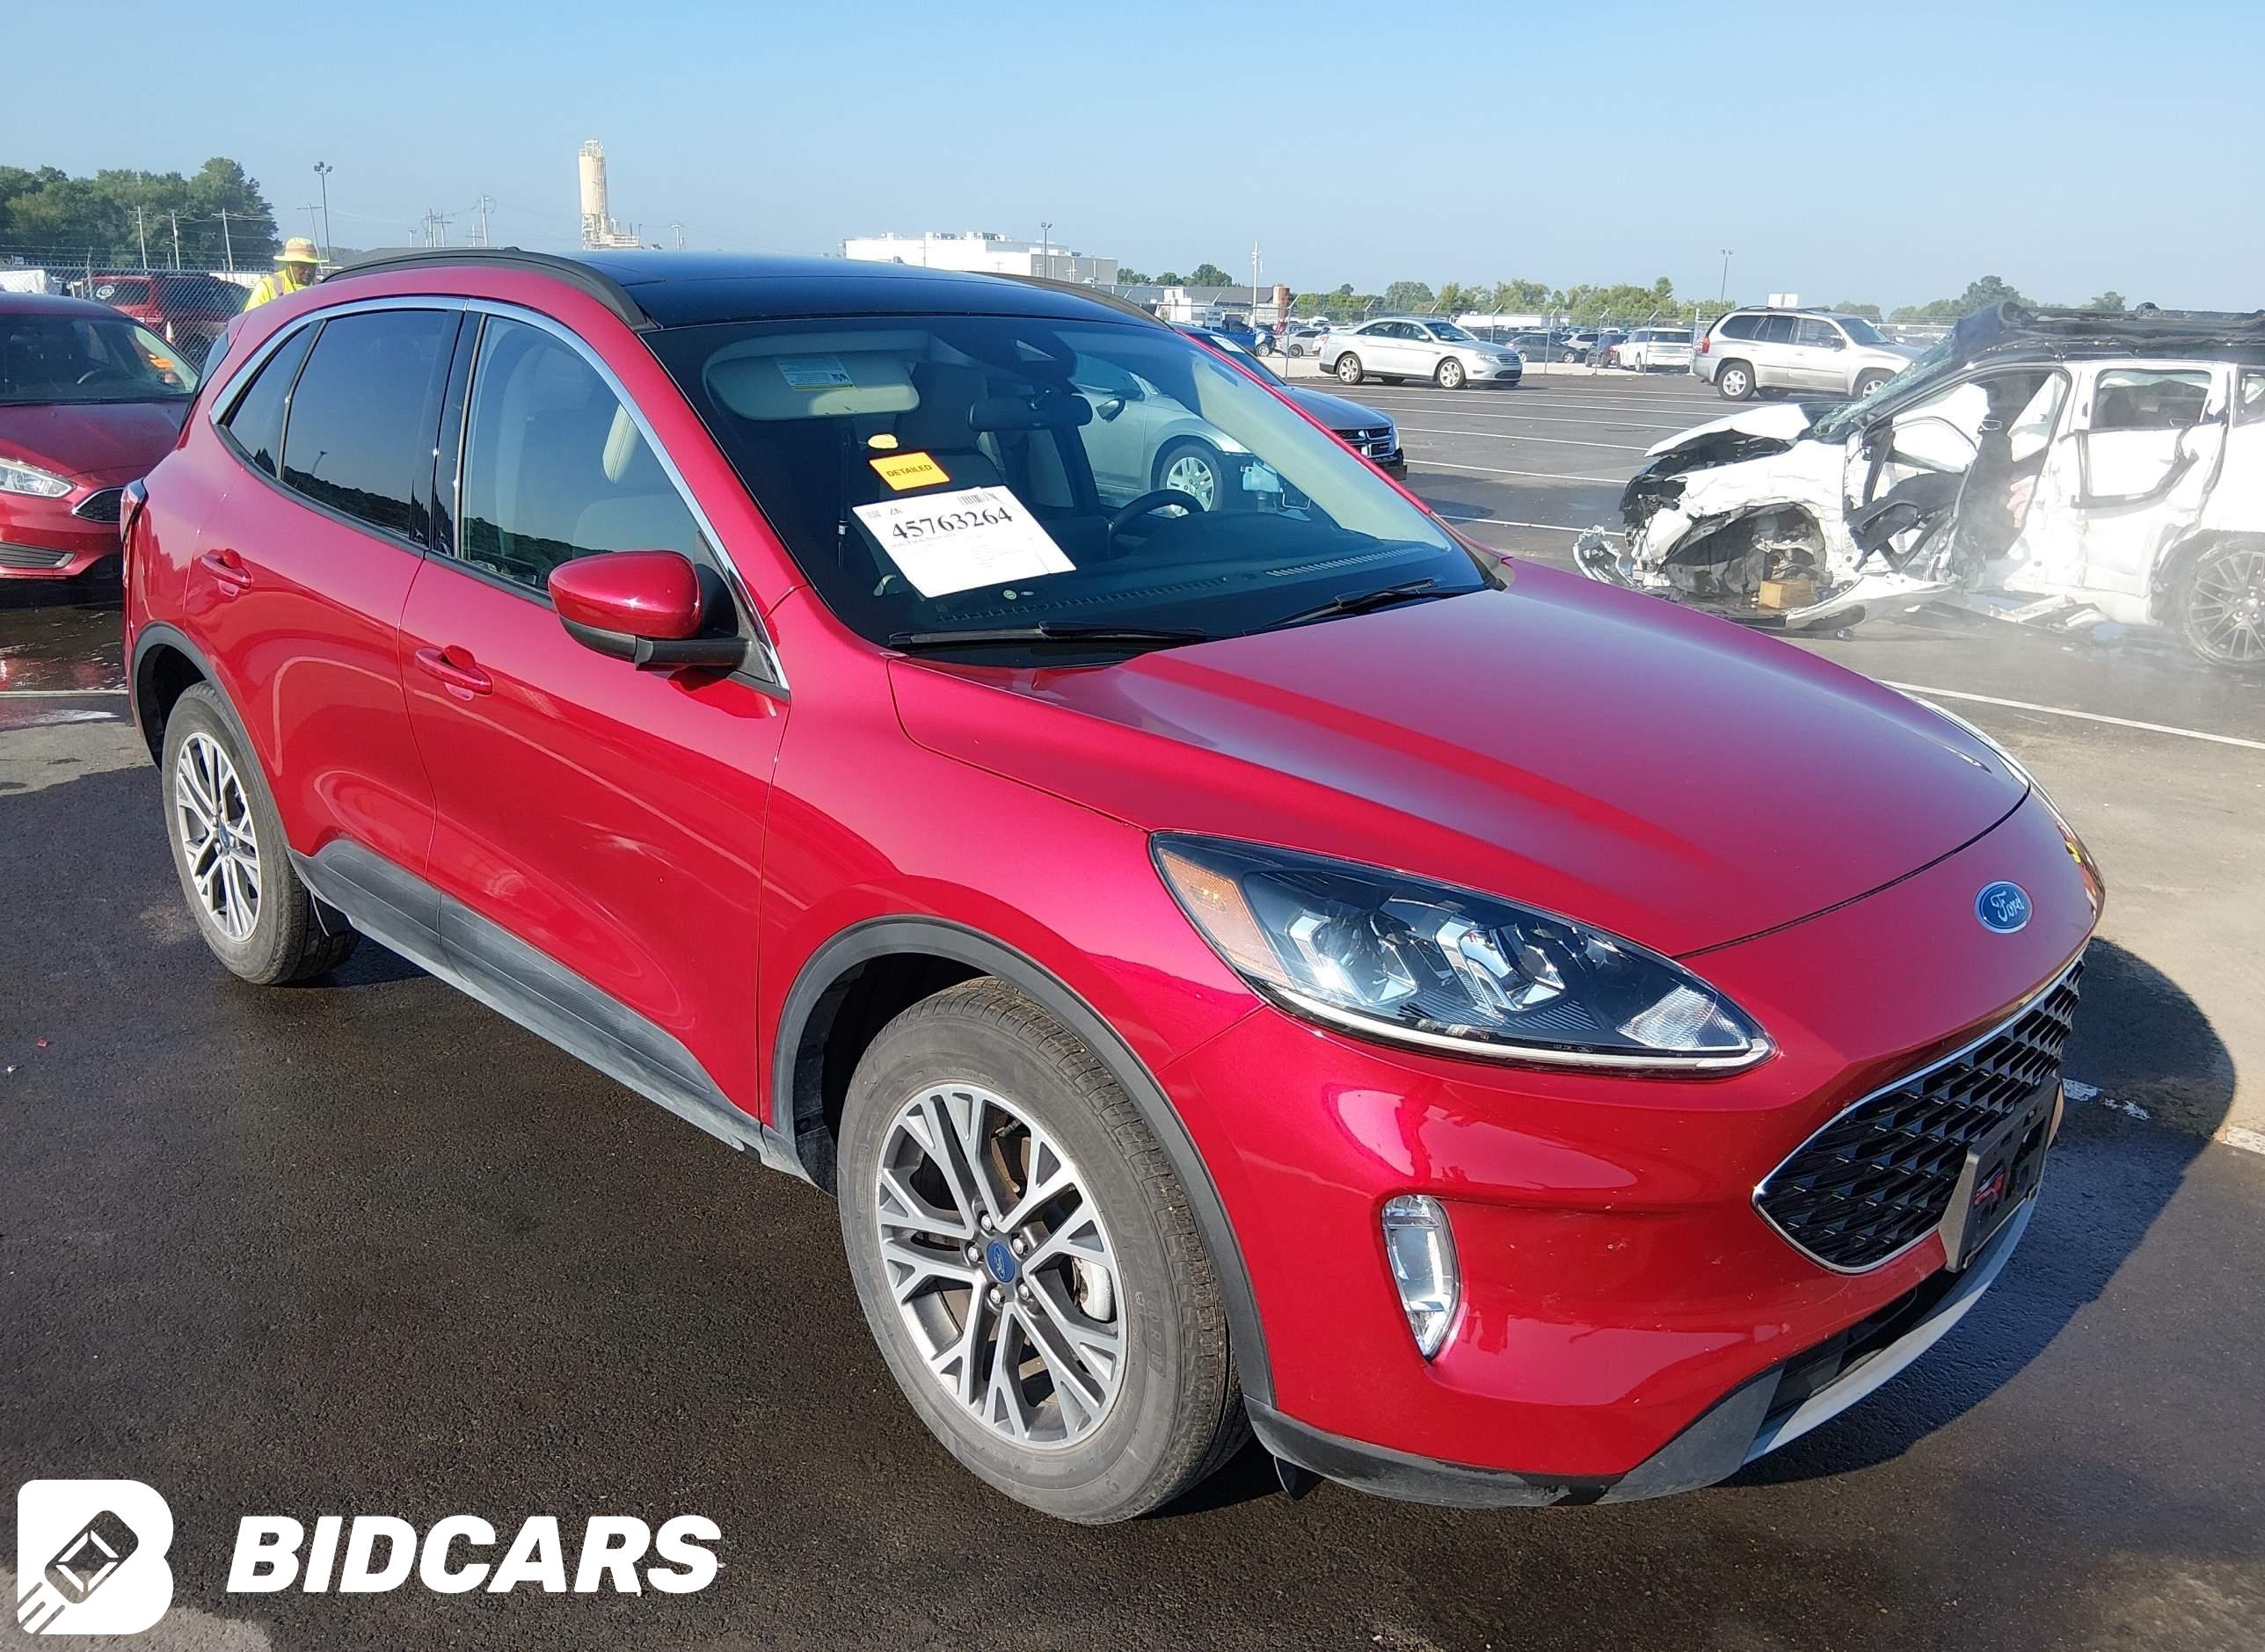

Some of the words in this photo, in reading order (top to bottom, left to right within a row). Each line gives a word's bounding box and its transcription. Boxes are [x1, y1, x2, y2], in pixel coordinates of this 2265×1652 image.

[885, 463, 933, 478] DETAILED
[892, 506, 1013, 539] 45763264
[1990, 890, 2025, 922] Ford
